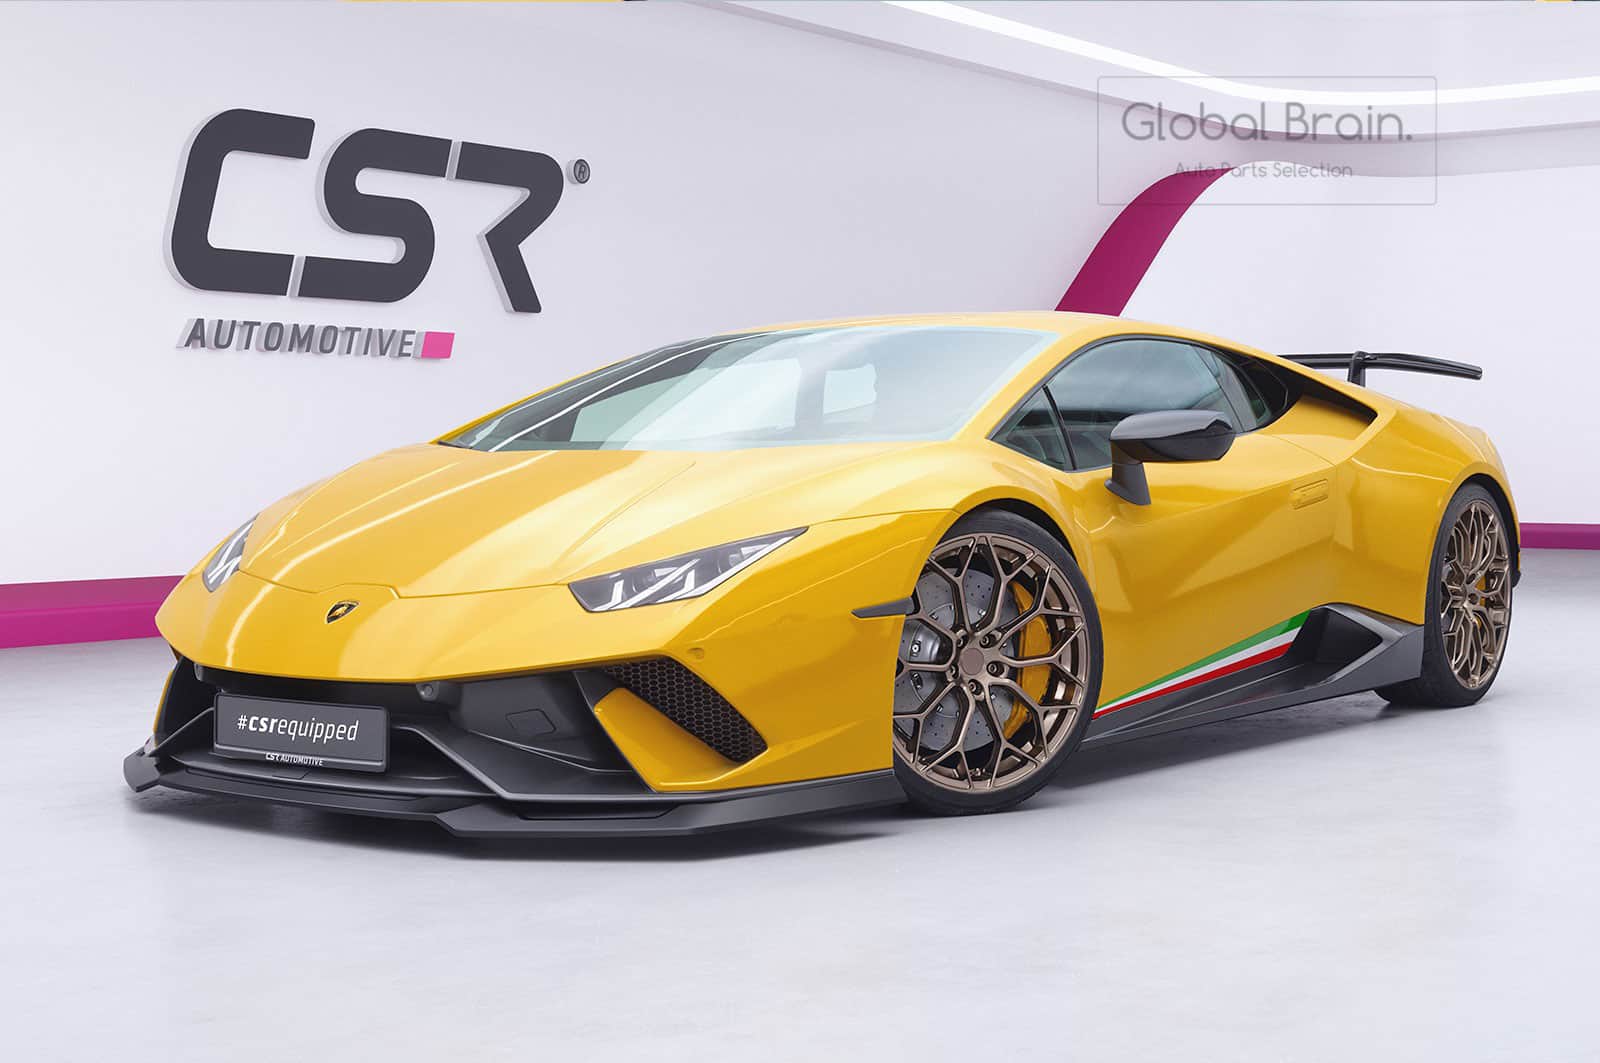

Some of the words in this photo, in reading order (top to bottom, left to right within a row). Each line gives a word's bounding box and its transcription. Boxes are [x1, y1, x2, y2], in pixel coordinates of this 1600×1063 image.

[180, 318, 417, 358] AUTOMOTIVE
[237, 714, 359, 744] #csrequipped
[280, 753, 323, 766] AUTOMOTIVE
